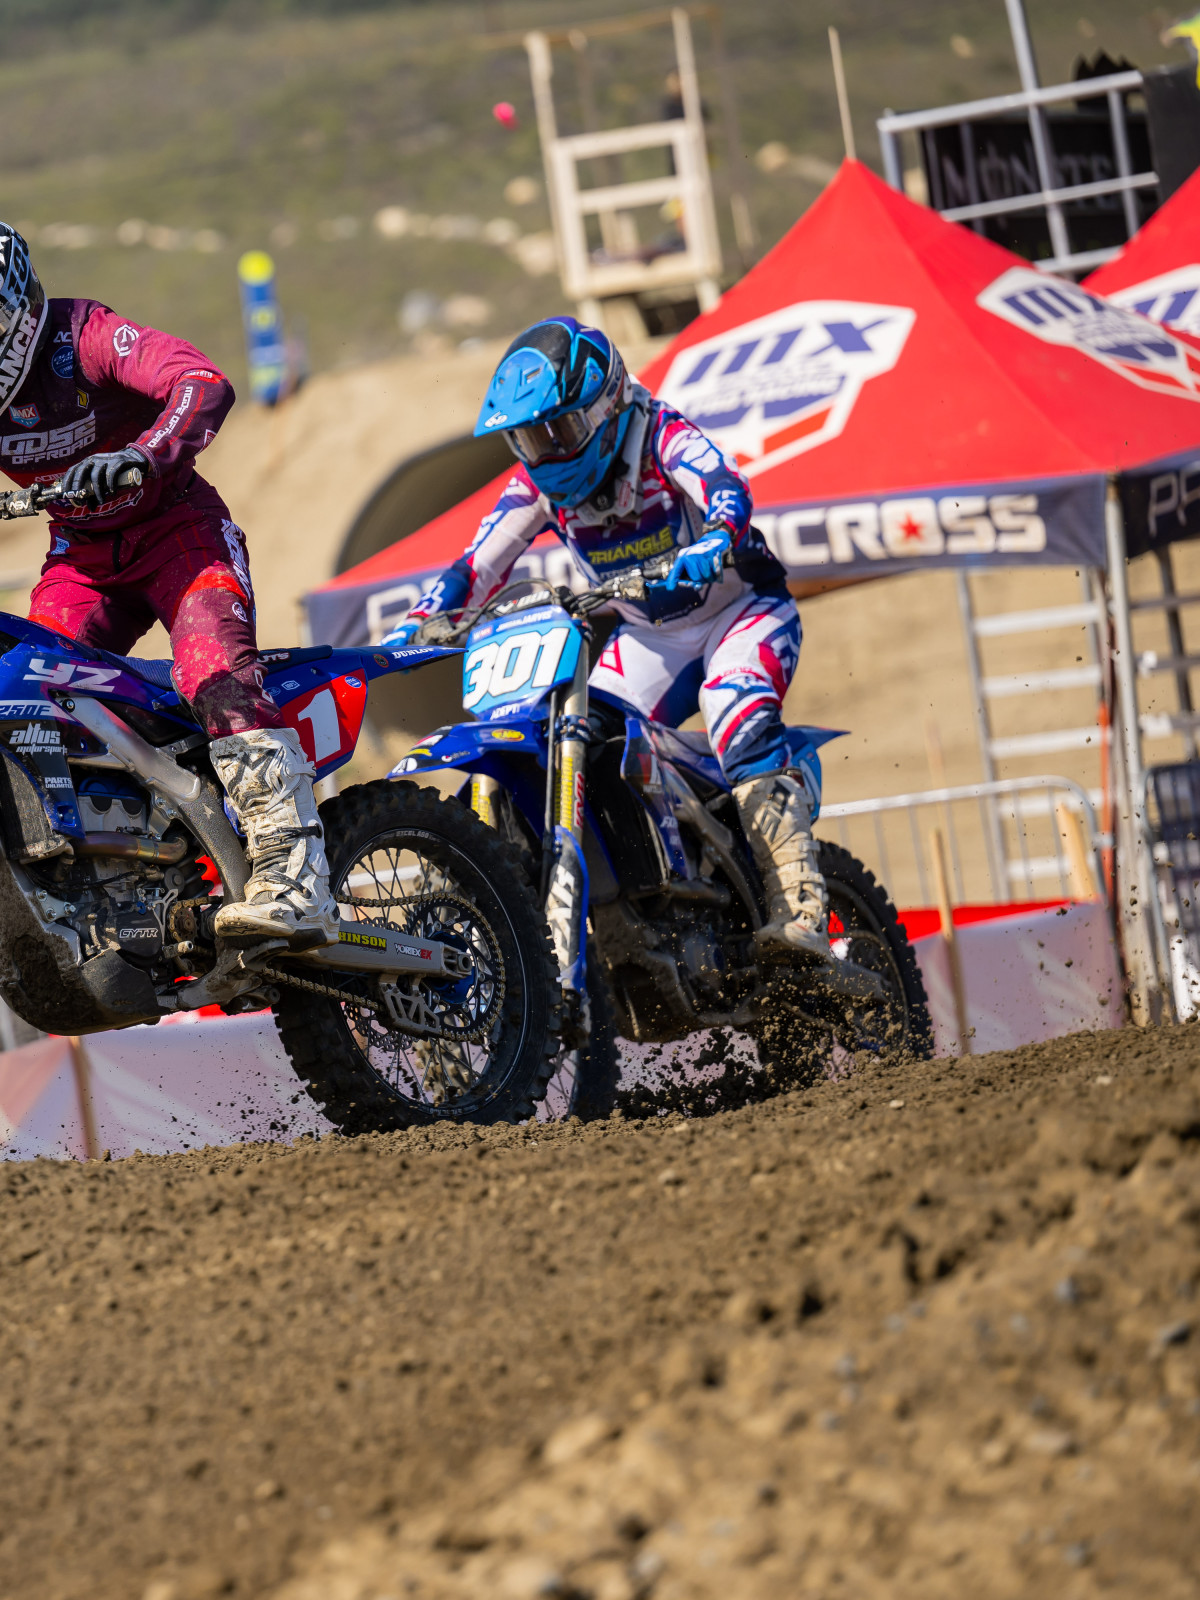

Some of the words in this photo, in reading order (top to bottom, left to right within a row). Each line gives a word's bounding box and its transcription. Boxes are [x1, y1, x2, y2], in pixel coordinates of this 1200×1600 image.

[11, 432, 96, 465] OFFROAD
[9, 501, 30, 510] ASV
[22, 658, 122, 692] YZ
[462, 627, 571, 710] 301
[9, 721, 61, 745] altus
[296, 686, 342, 764] 1
[44, 776, 73, 784] PARTS
[119, 928, 159, 939] GYTR
